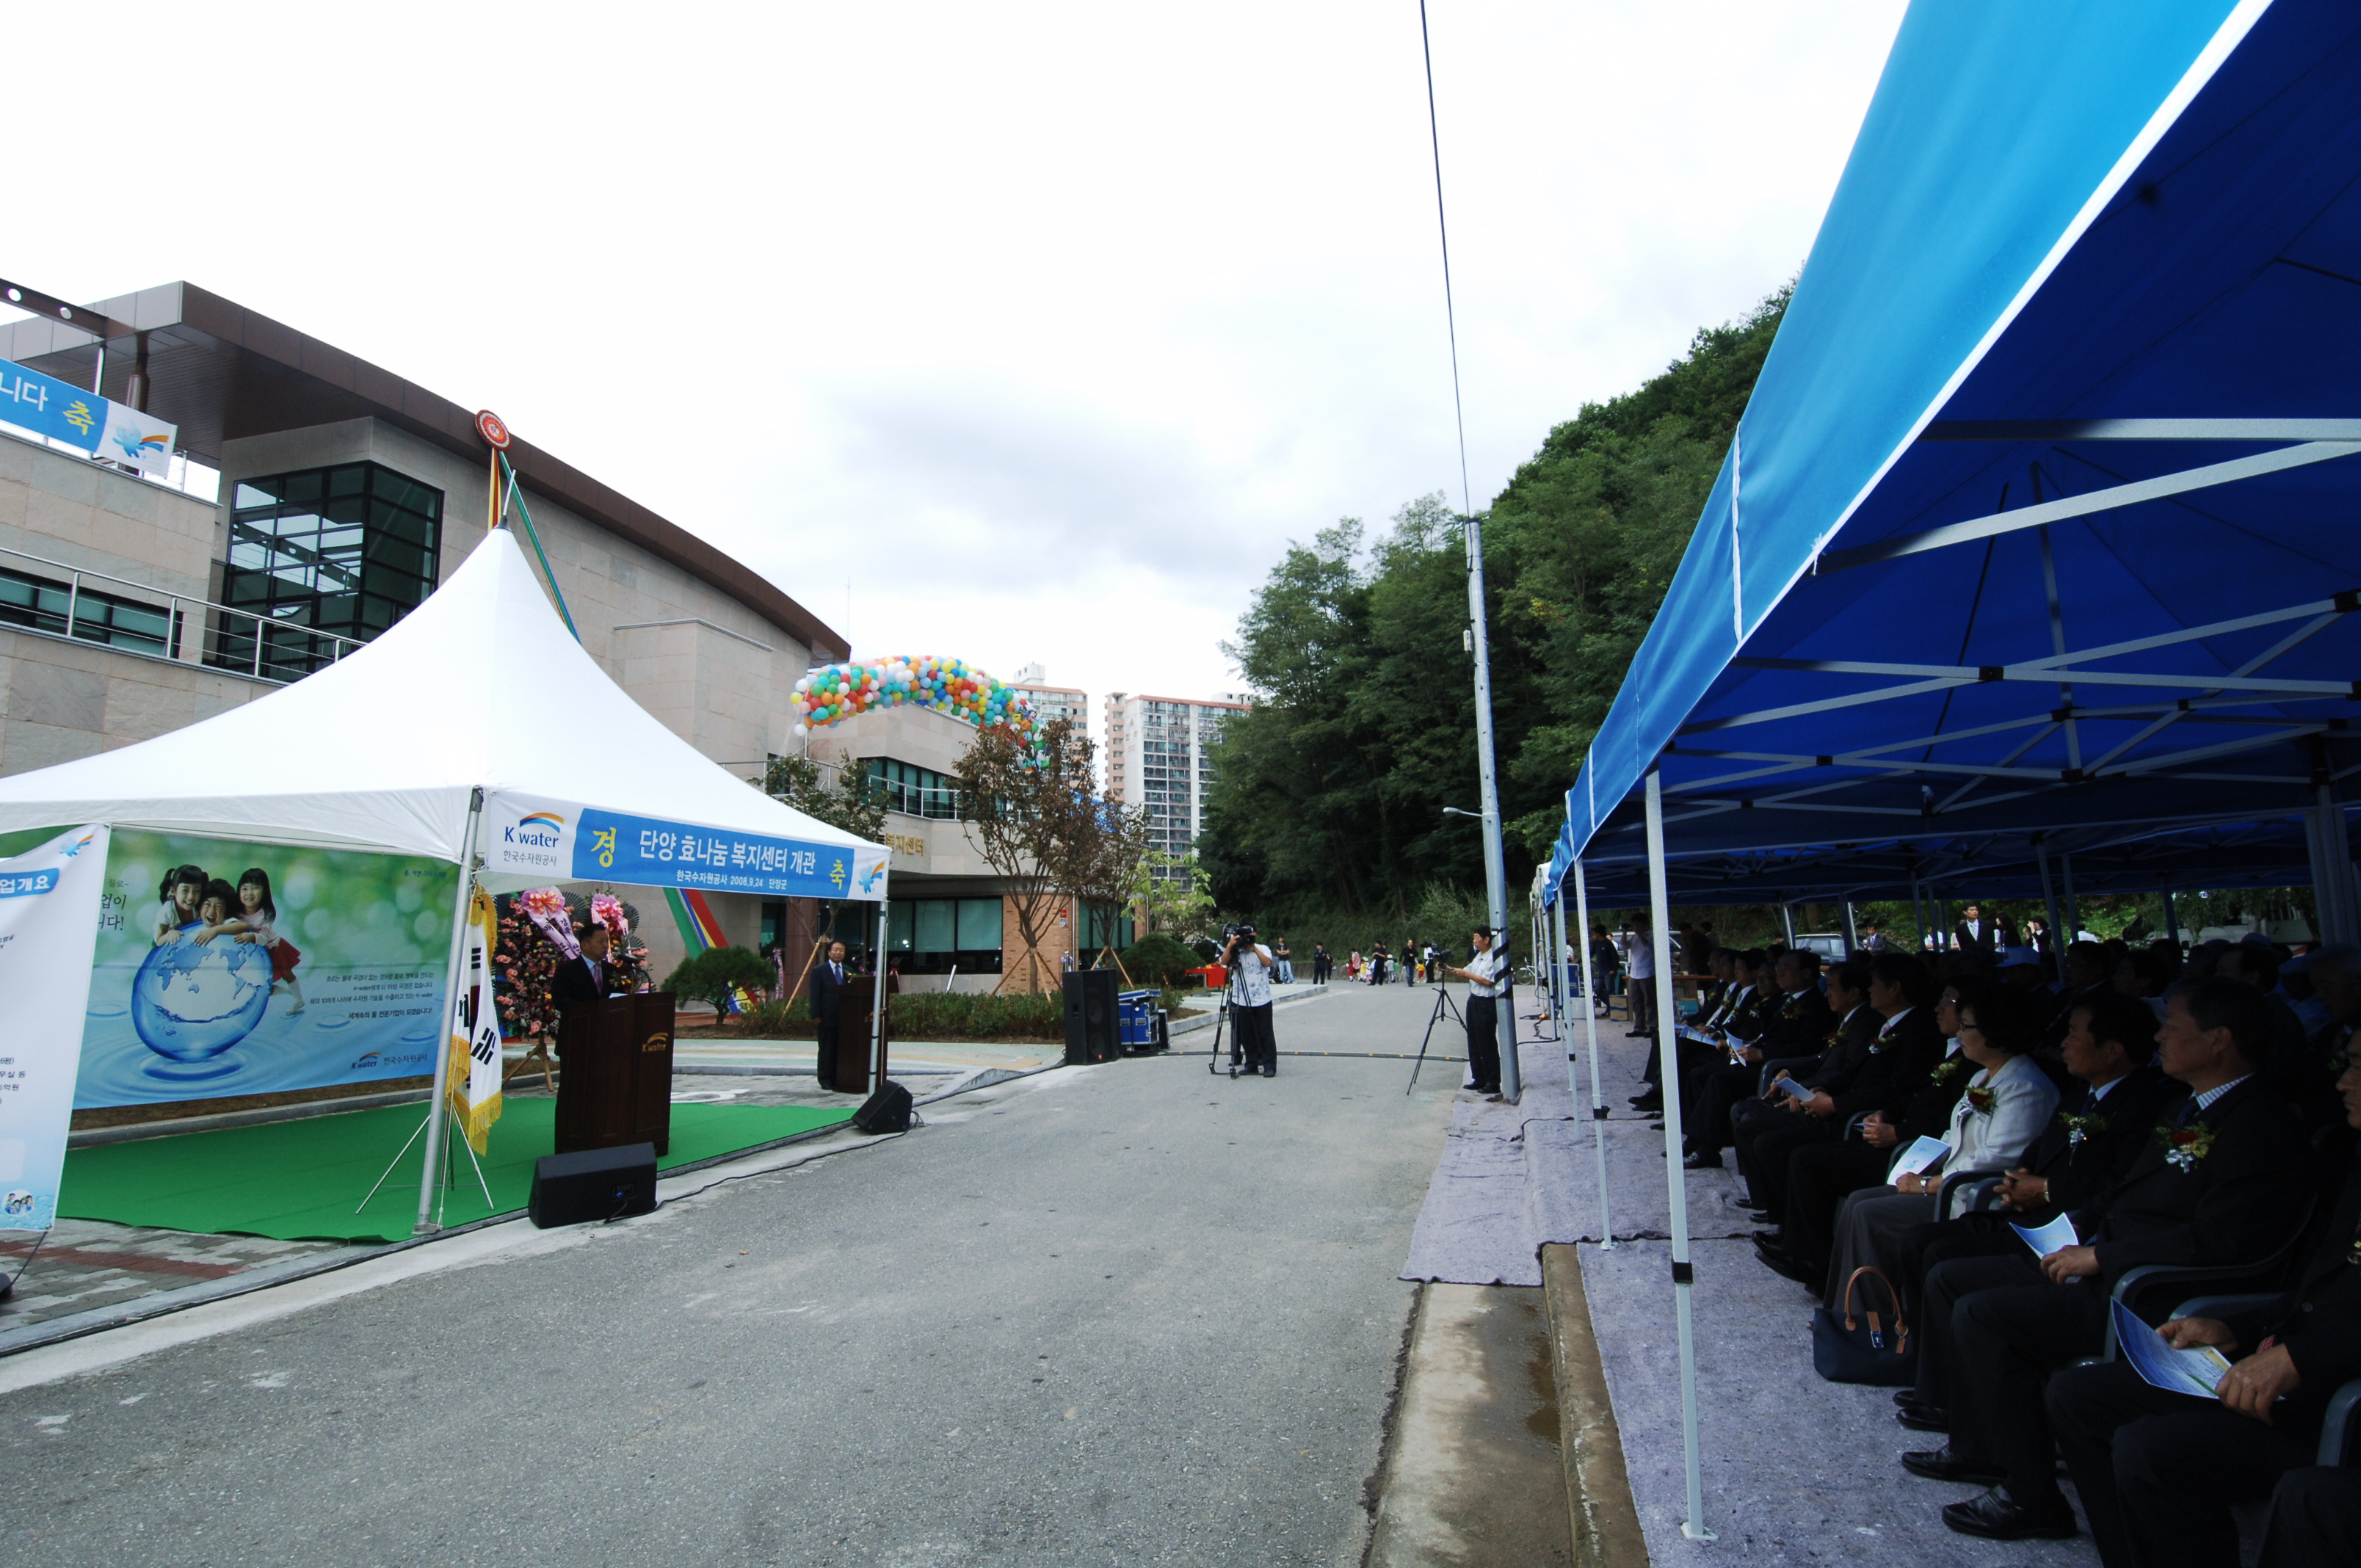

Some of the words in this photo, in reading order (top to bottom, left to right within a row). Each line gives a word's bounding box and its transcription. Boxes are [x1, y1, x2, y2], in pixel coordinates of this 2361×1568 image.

[0, 371, 48, 411] 니다
[62, 400, 95, 435] 축
[504, 827, 515, 843] K
[519, 832, 559, 848] water
[875, 833, 924, 857] 복지센터
[504, 850, 557, 866] 한국수자원공사
[590, 827, 616, 868] 경
[640, 830, 676, 861] 단양
[678, 835, 728, 866] 효나눔
[731, 842, 788, 873] 복지센터
[790, 850, 816, 875] 개관
[830, 859, 846, 890] 축
[0, 875, 50, 893] 업개요
[677, 870, 728, 885] 한국수자원공사
[730, 876, 763, 888] 2008.9.24
[769, 879, 787, 890] 단양군
